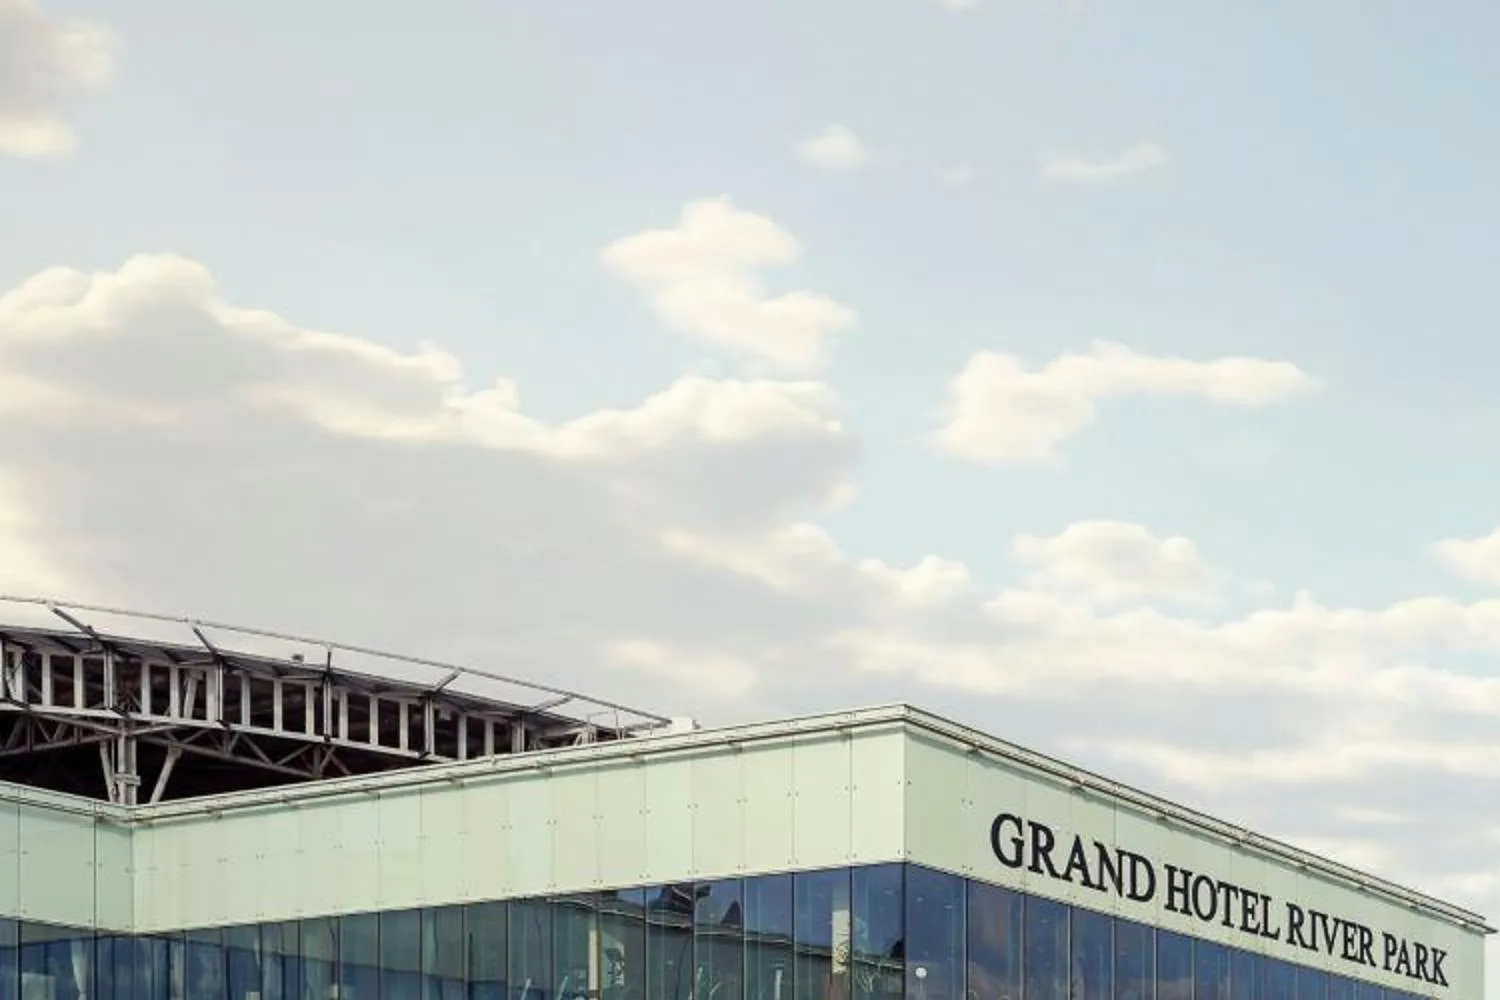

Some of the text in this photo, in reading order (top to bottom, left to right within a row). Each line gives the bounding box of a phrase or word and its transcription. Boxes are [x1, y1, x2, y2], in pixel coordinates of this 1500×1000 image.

[990, 813, 1449, 987] GRAND HOTEL RIVER PARK
